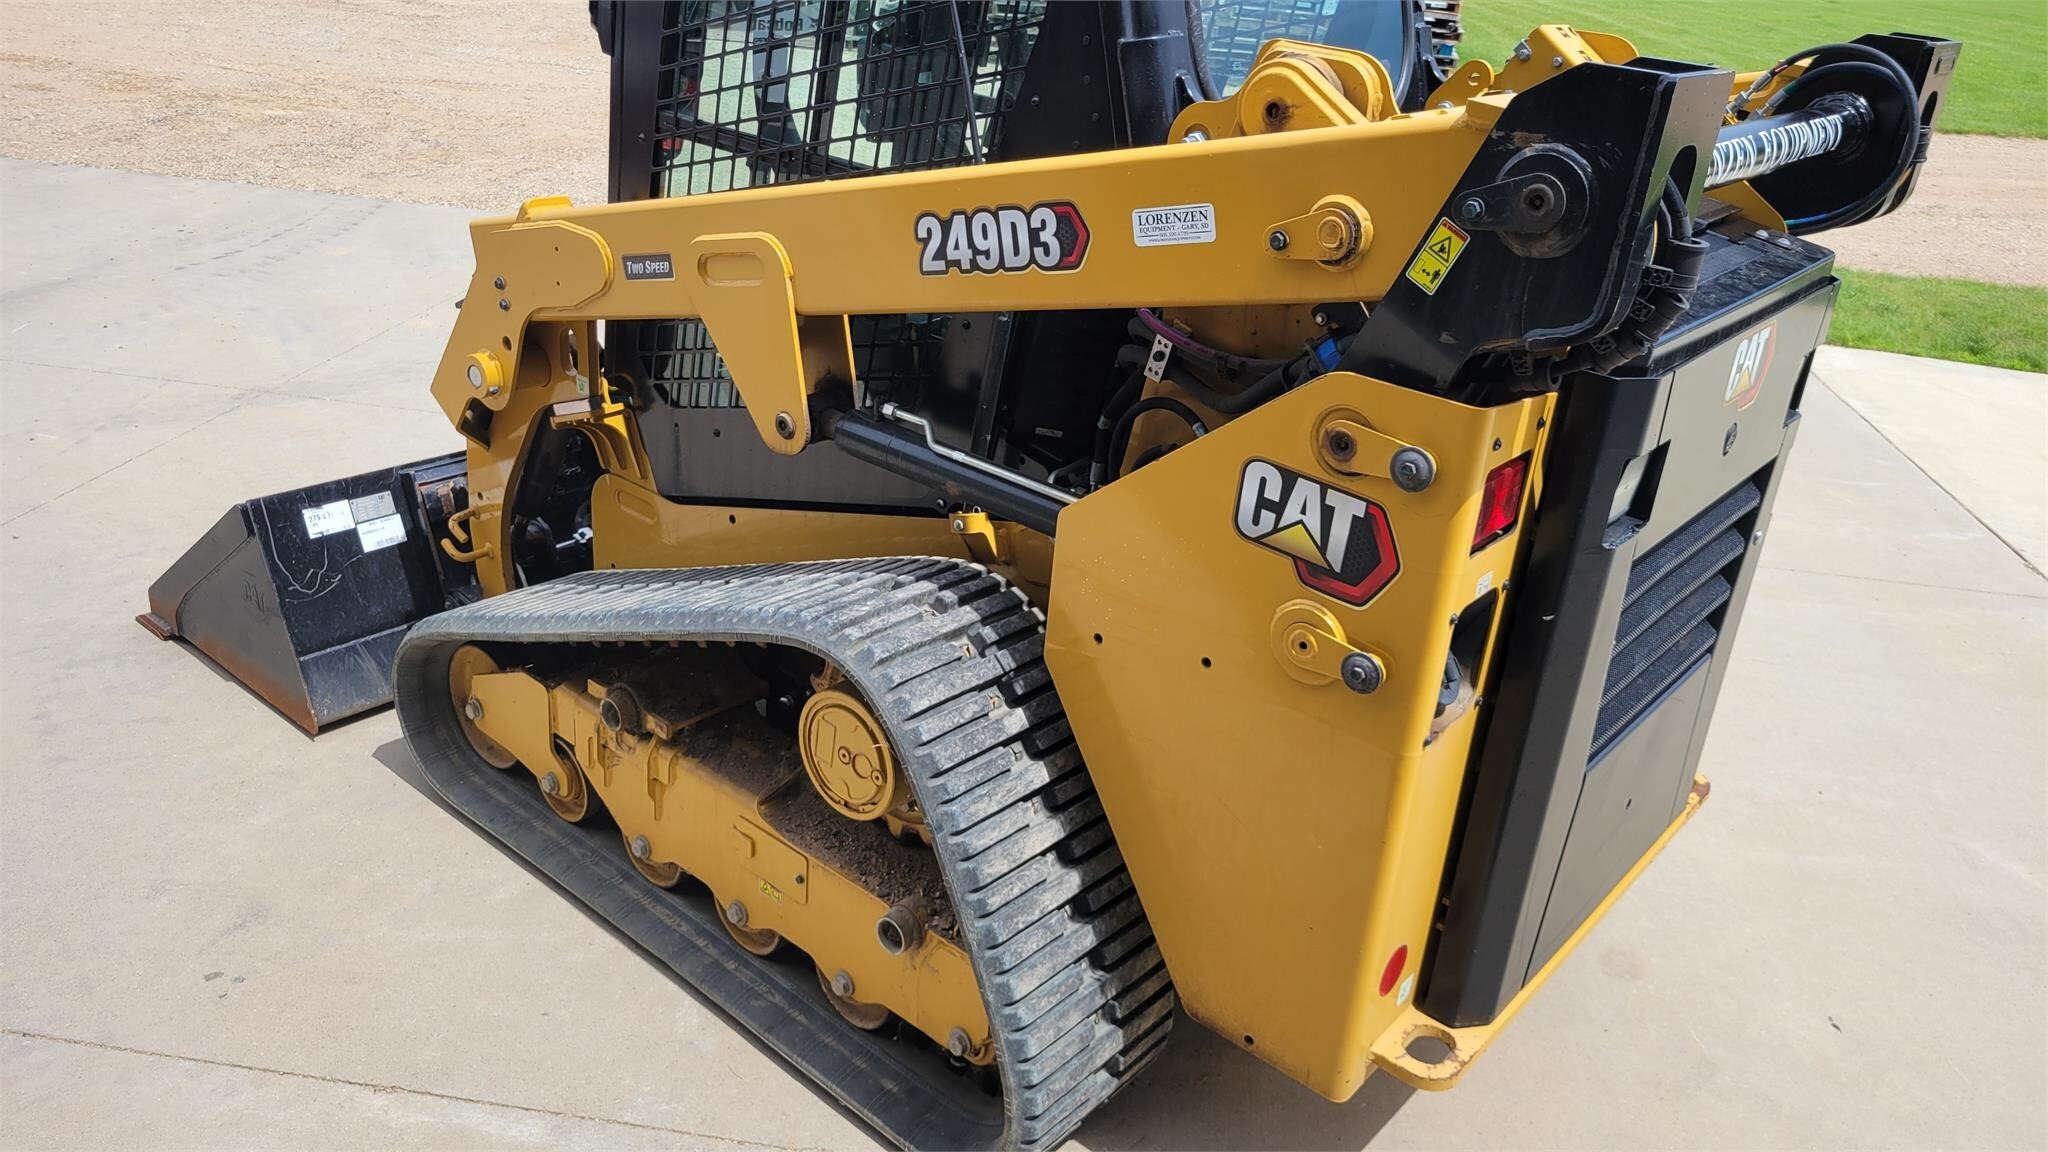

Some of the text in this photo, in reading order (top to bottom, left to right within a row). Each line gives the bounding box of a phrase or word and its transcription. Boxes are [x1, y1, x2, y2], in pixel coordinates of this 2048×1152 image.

[1705, 114, 1843, 186] NZEN EQUIPMENT
[917, 206, 1061, 272] 249D3
[1137, 209, 1209, 227] LORENZEN
[1139, 225, 1176, 234] EQUIPMENT
[1181, 223, 1200, 231] GARY,
[1725, 326, 1771, 401] CAT
[1237, 461, 1367, 573] CAT
